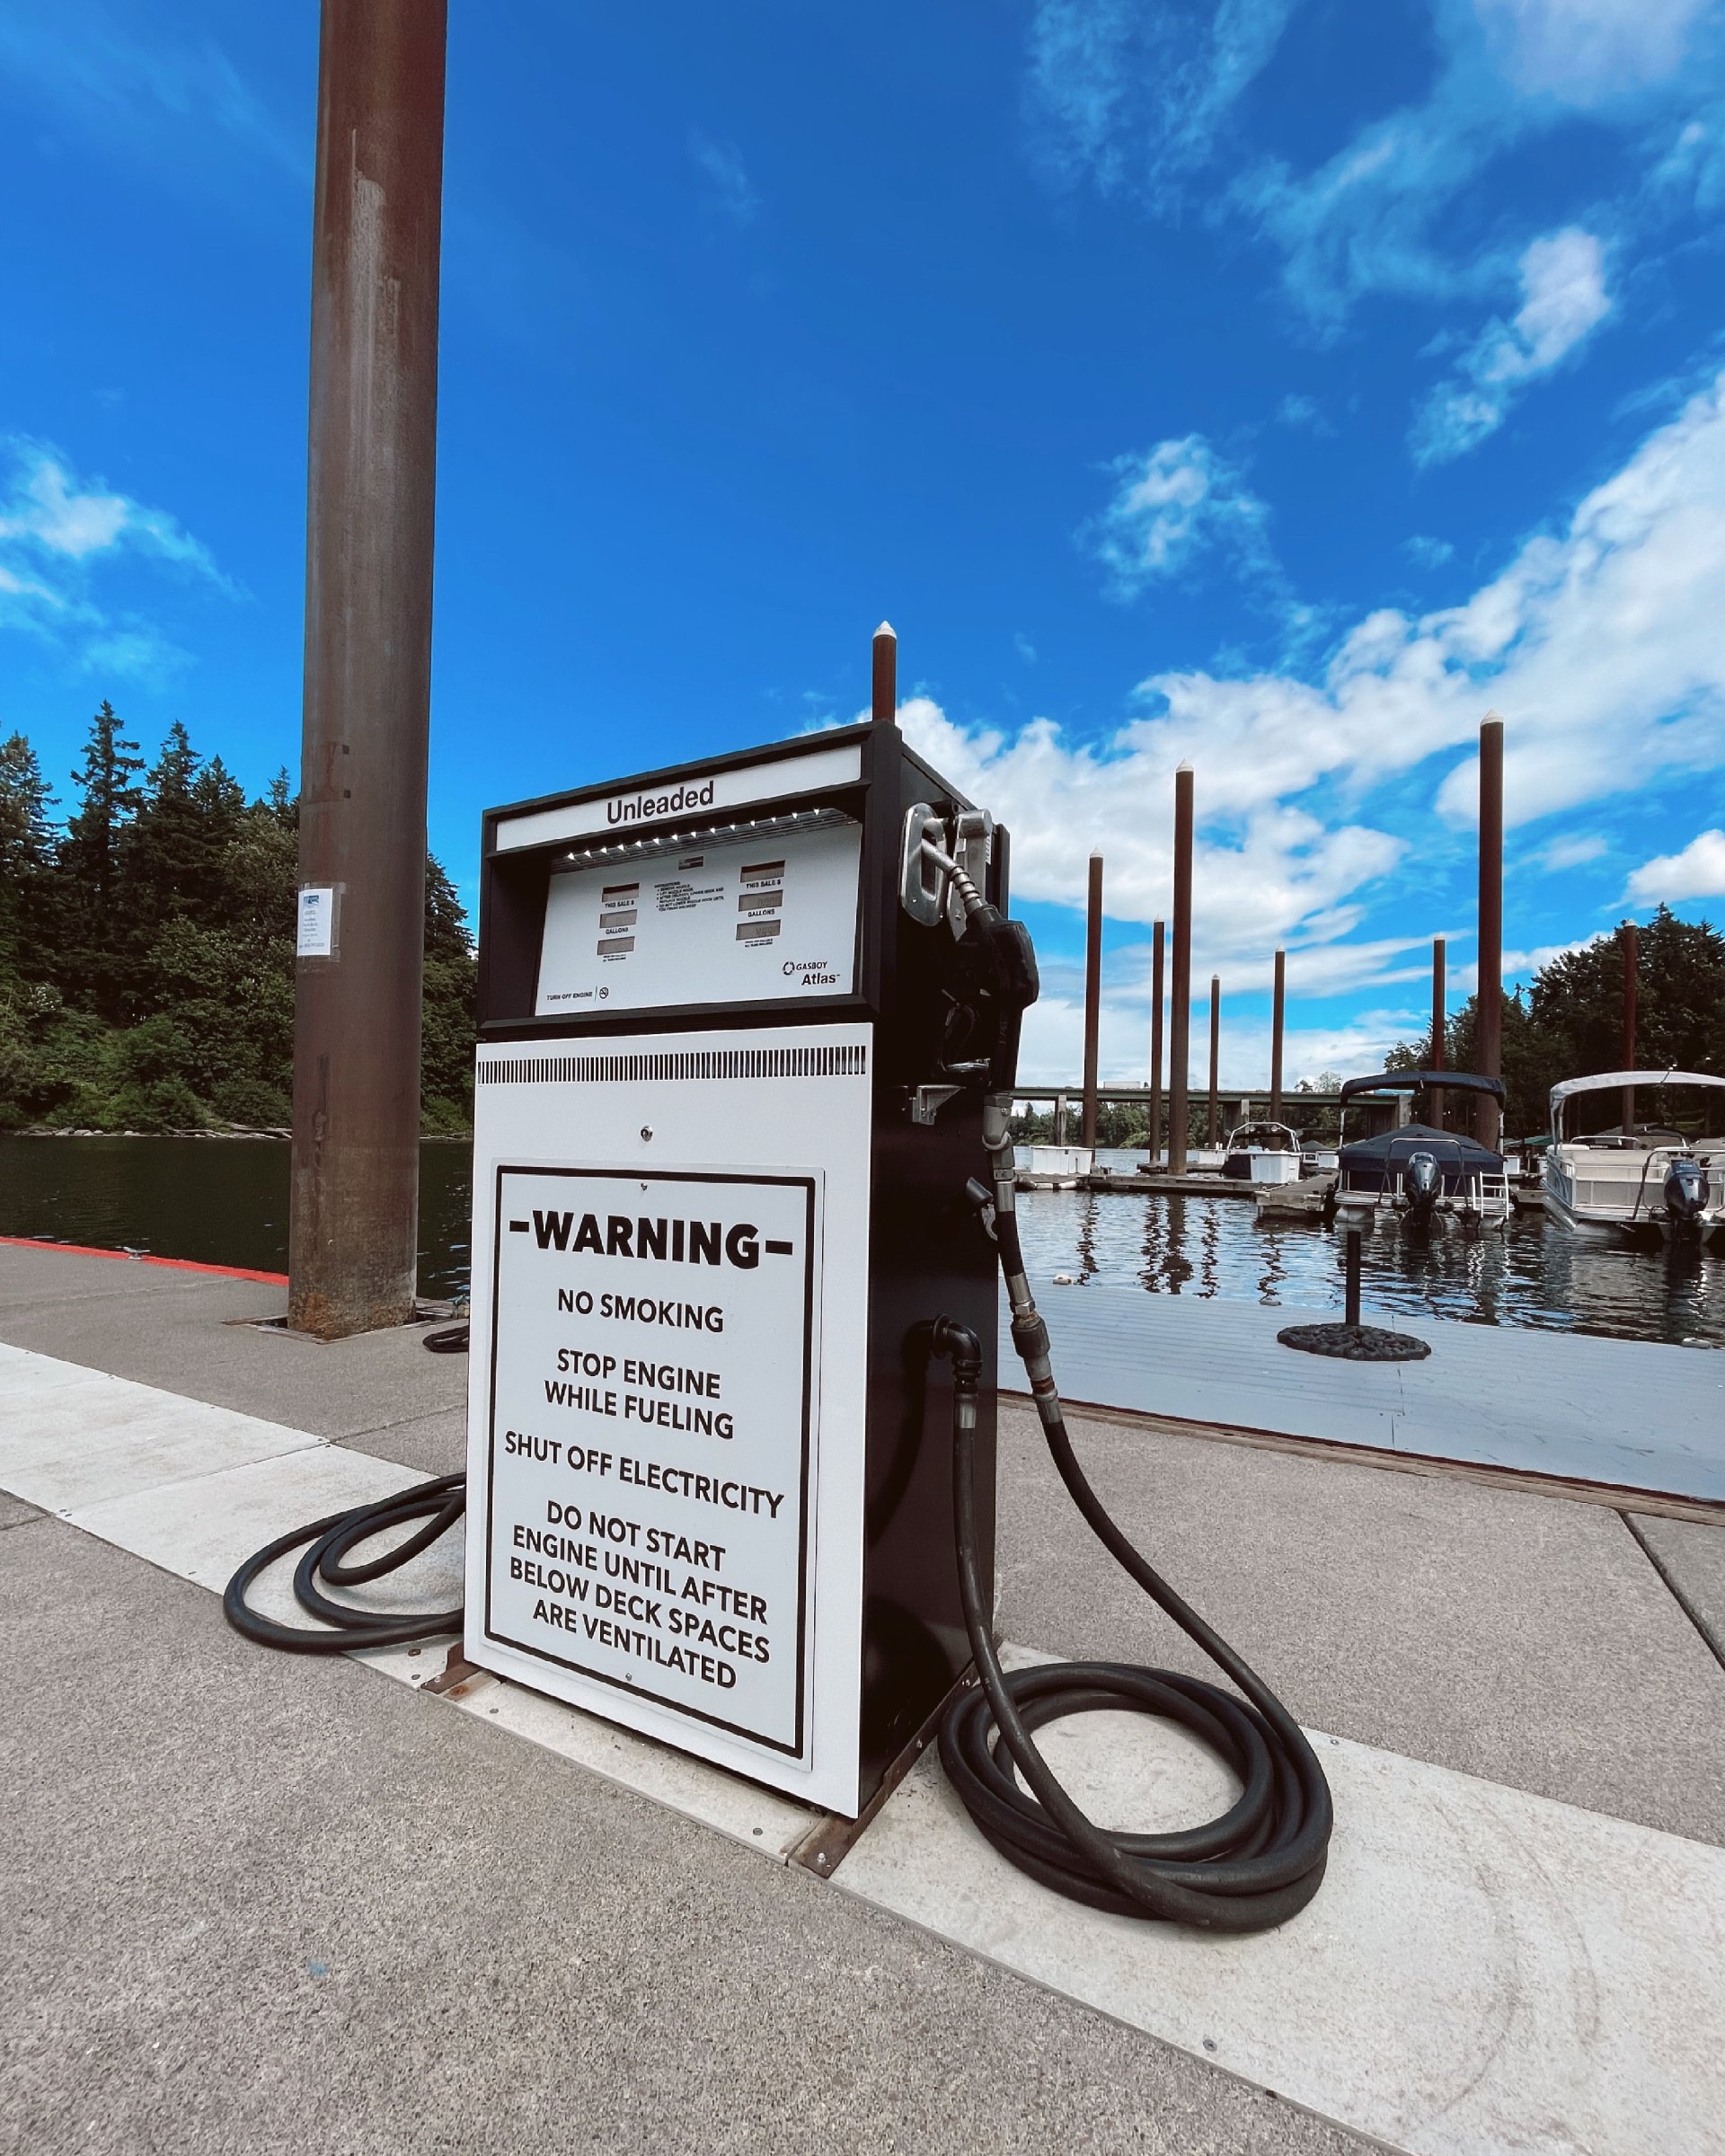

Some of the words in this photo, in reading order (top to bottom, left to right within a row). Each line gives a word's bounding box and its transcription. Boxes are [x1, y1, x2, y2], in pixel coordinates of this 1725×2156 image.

[607, 780, 714, 824] Unleaded
[747, 881, 759, 889] THIS
[760, 879, 776, 888] SALE
[748, 908, 775, 917] GALLONS
[796, 961, 827, 970] GASBOY
[558, 1288, 593, 1315] NO
[600, 1294, 723, 1333] SMOKING
[557, 1348, 616, 1379] STOP
[624, 1359, 721, 1399] ENGINE
[544, 1380, 616, 1417] WHILE
[624, 1394, 733, 1439] FUELING
[505, 1430, 562, 1464] SHUT
[567, 1445, 612, 1476] OFF
[619, 1456, 784, 1519] ELECTRICITY
[547, 1499, 582, 1530] DO
[589, 1511, 641, 1547] NOT
[646, 1527, 726, 1572] START
[513, 1524, 597, 1571] ENGINE
[605, 1551, 677, 1596] UNTIL
[681, 1576, 768, 1625] AFTER
[510, 1556, 589, 1602] BELOW
[596, 1583, 662, 1628] DECK
[668, 1607, 770, 1664] SPACES
[533, 1599, 577, 1634] ARE
[582, 1613, 737, 1689] VENTILATED
